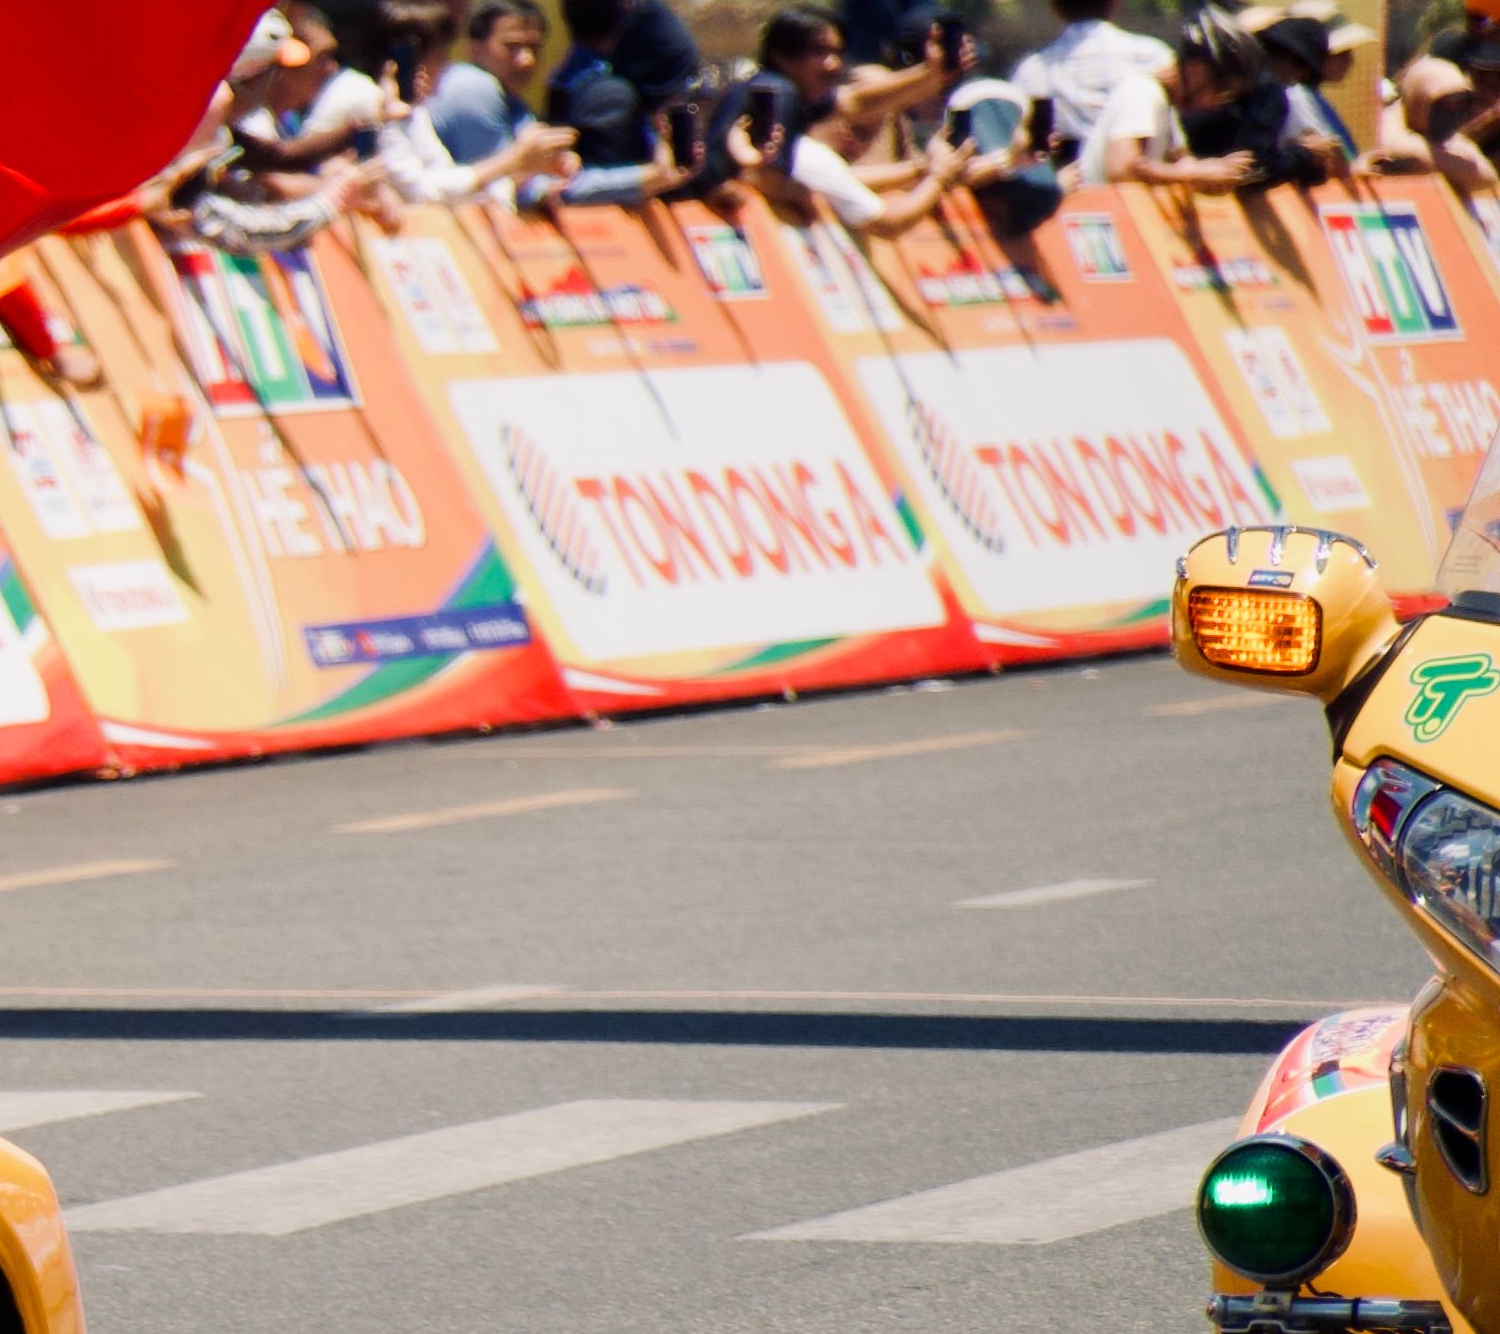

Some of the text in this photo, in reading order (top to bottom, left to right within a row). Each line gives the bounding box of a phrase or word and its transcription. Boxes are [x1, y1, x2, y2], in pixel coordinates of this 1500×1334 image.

[1327, 218, 1454, 329] HTV
[573, 457, 908, 588] TON DONG A
[973, 427, 1267, 549] TON DONG A
